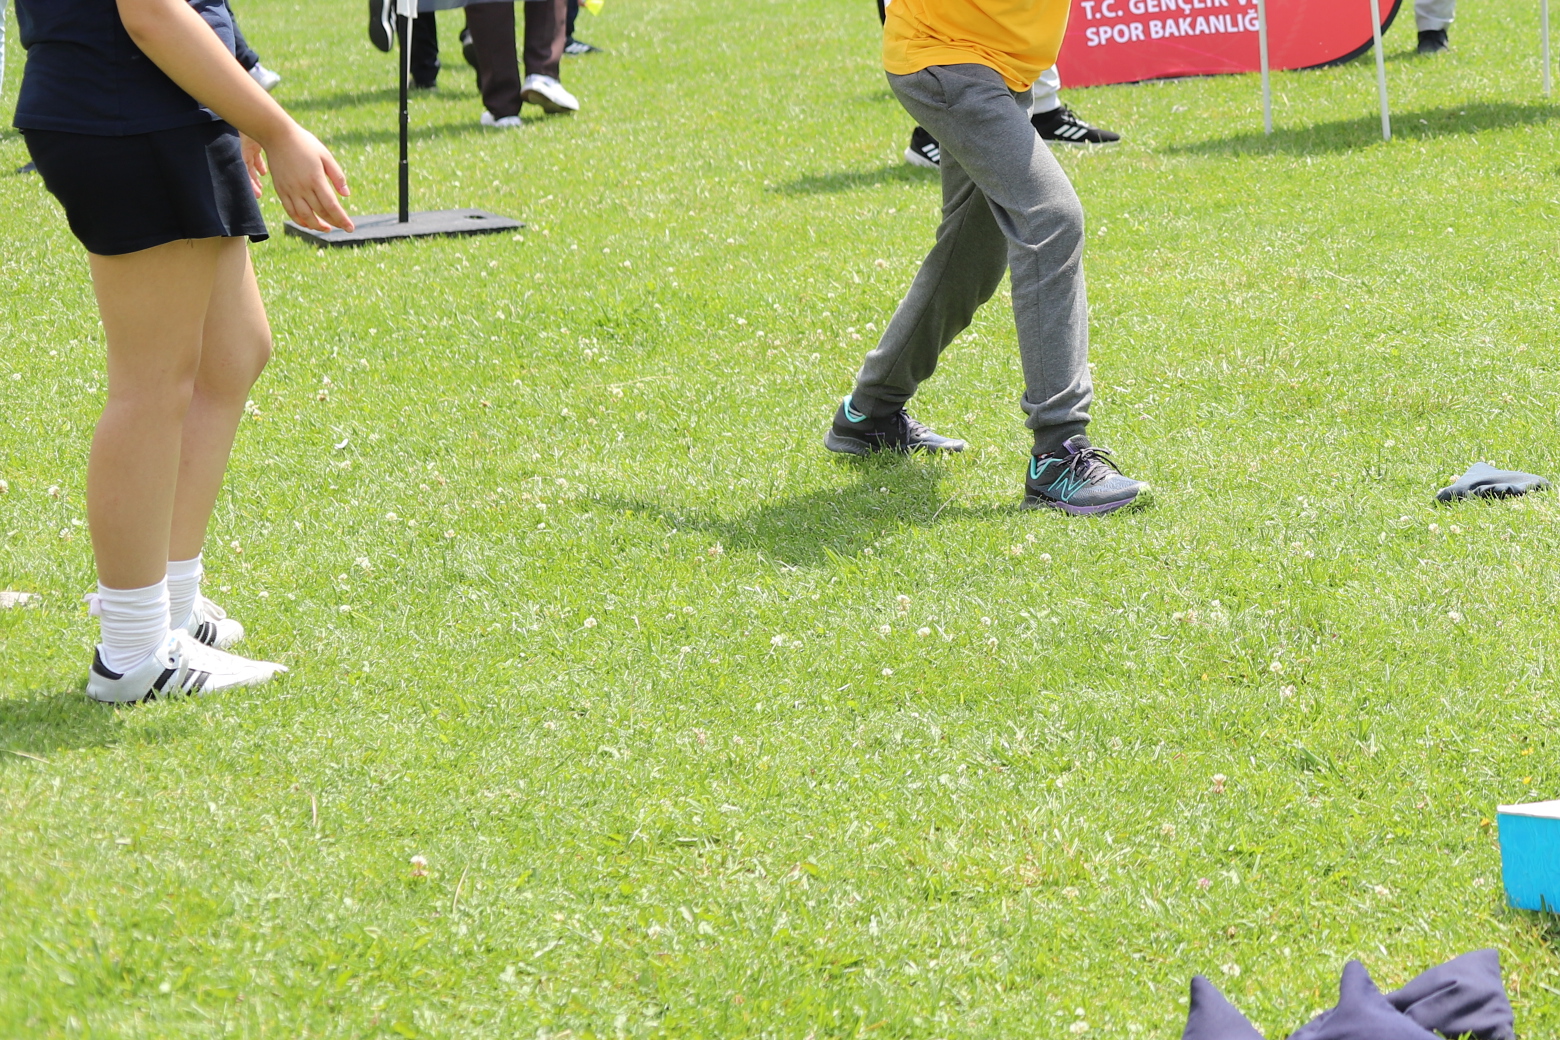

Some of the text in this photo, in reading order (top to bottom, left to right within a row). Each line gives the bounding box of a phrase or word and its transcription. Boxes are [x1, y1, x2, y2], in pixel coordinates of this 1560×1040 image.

[1081, 0, 1124, 20] T.C.
[1085, 8, 1260, 47] SPOR BAKANLIĞ
